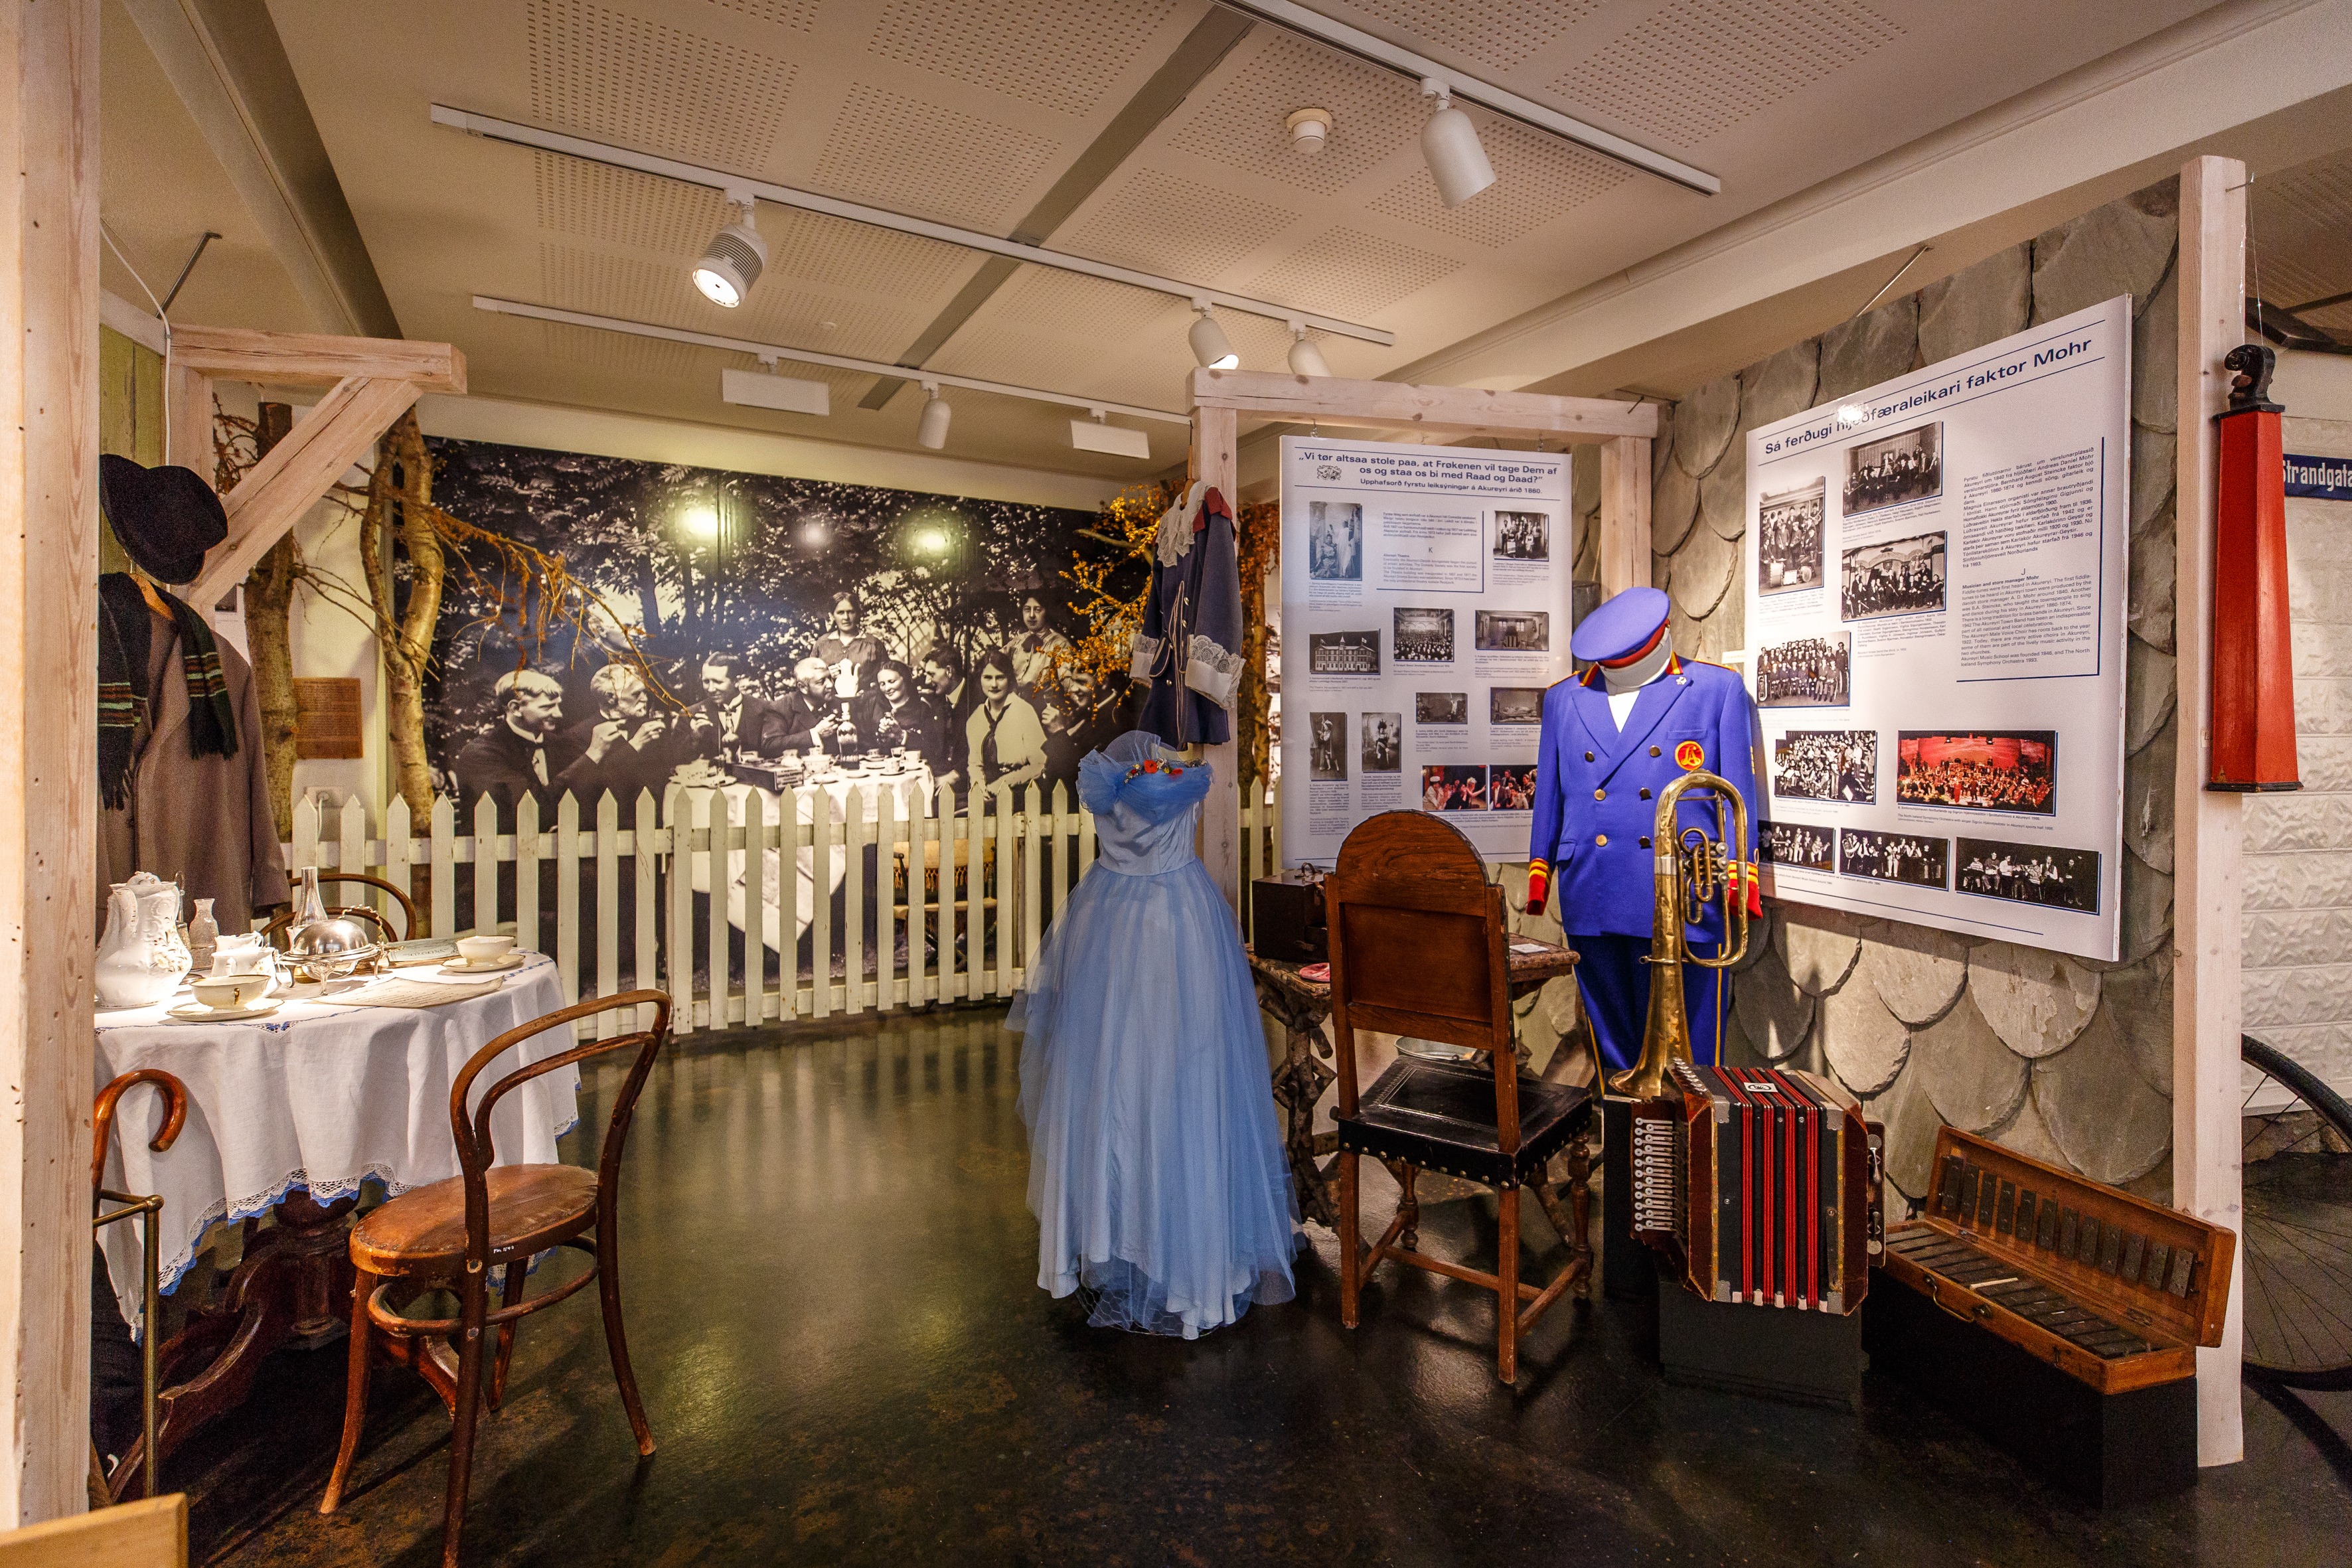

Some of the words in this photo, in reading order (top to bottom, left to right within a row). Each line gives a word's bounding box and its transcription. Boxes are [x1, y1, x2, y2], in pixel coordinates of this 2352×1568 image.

[1766, 441, 1780, 454] Sá
[1785, 423, 1832, 448] ferðugi
[1966, 361, 2027, 389] faktor
[2034, 339, 2092, 367] Mohr
[1336, 455, 1367, 463] altsaa
[1436, 461, 1482, 470] Frøkenen
[1466, 472, 1491, 481] Raad
[2001, 477, 2023, 485] Bernhard
